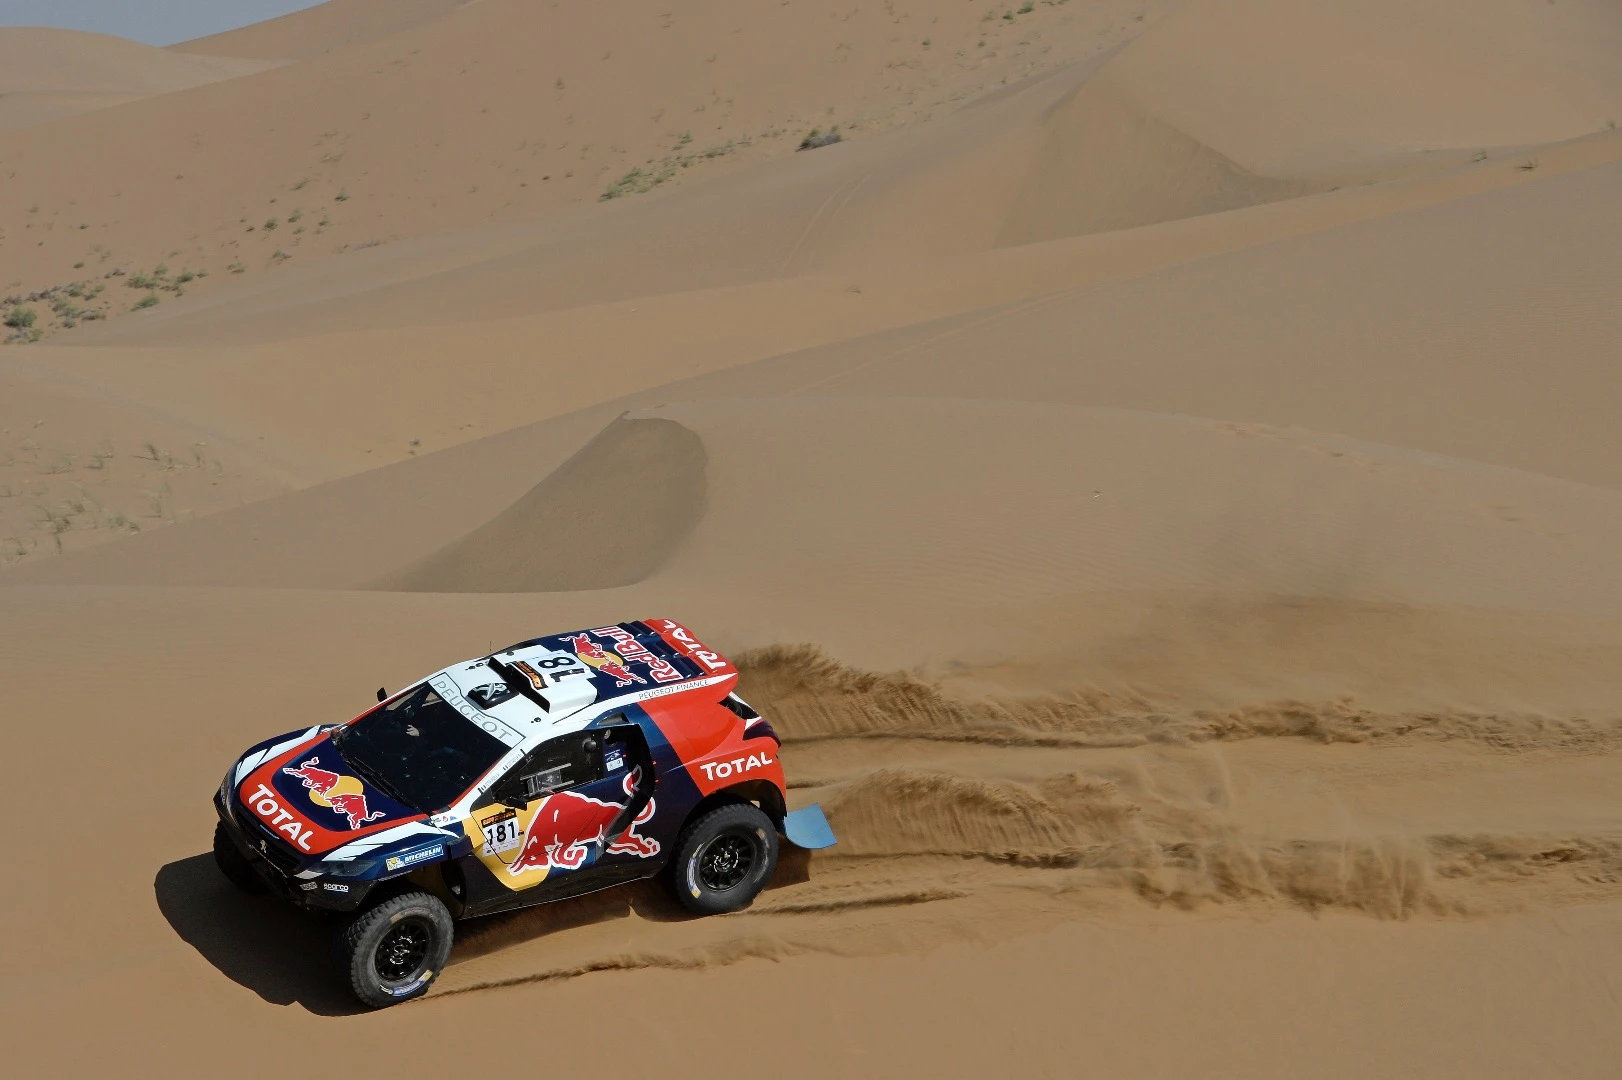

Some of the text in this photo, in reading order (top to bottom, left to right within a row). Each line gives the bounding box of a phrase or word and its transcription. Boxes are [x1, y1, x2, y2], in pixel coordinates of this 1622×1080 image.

[664, 619, 726, 670] TOTAL
[638, 680, 709, 700] PEUGEOT FINANCE
[433, 680, 513, 739] PEUGEOT
[700, 751, 773, 781] TOTAL
[248, 783, 314, 851] TOTAL
[487, 821, 516, 846] 181
[404, 846, 442, 864] MICHELIN
[323, 882, 349, 893] sparco
